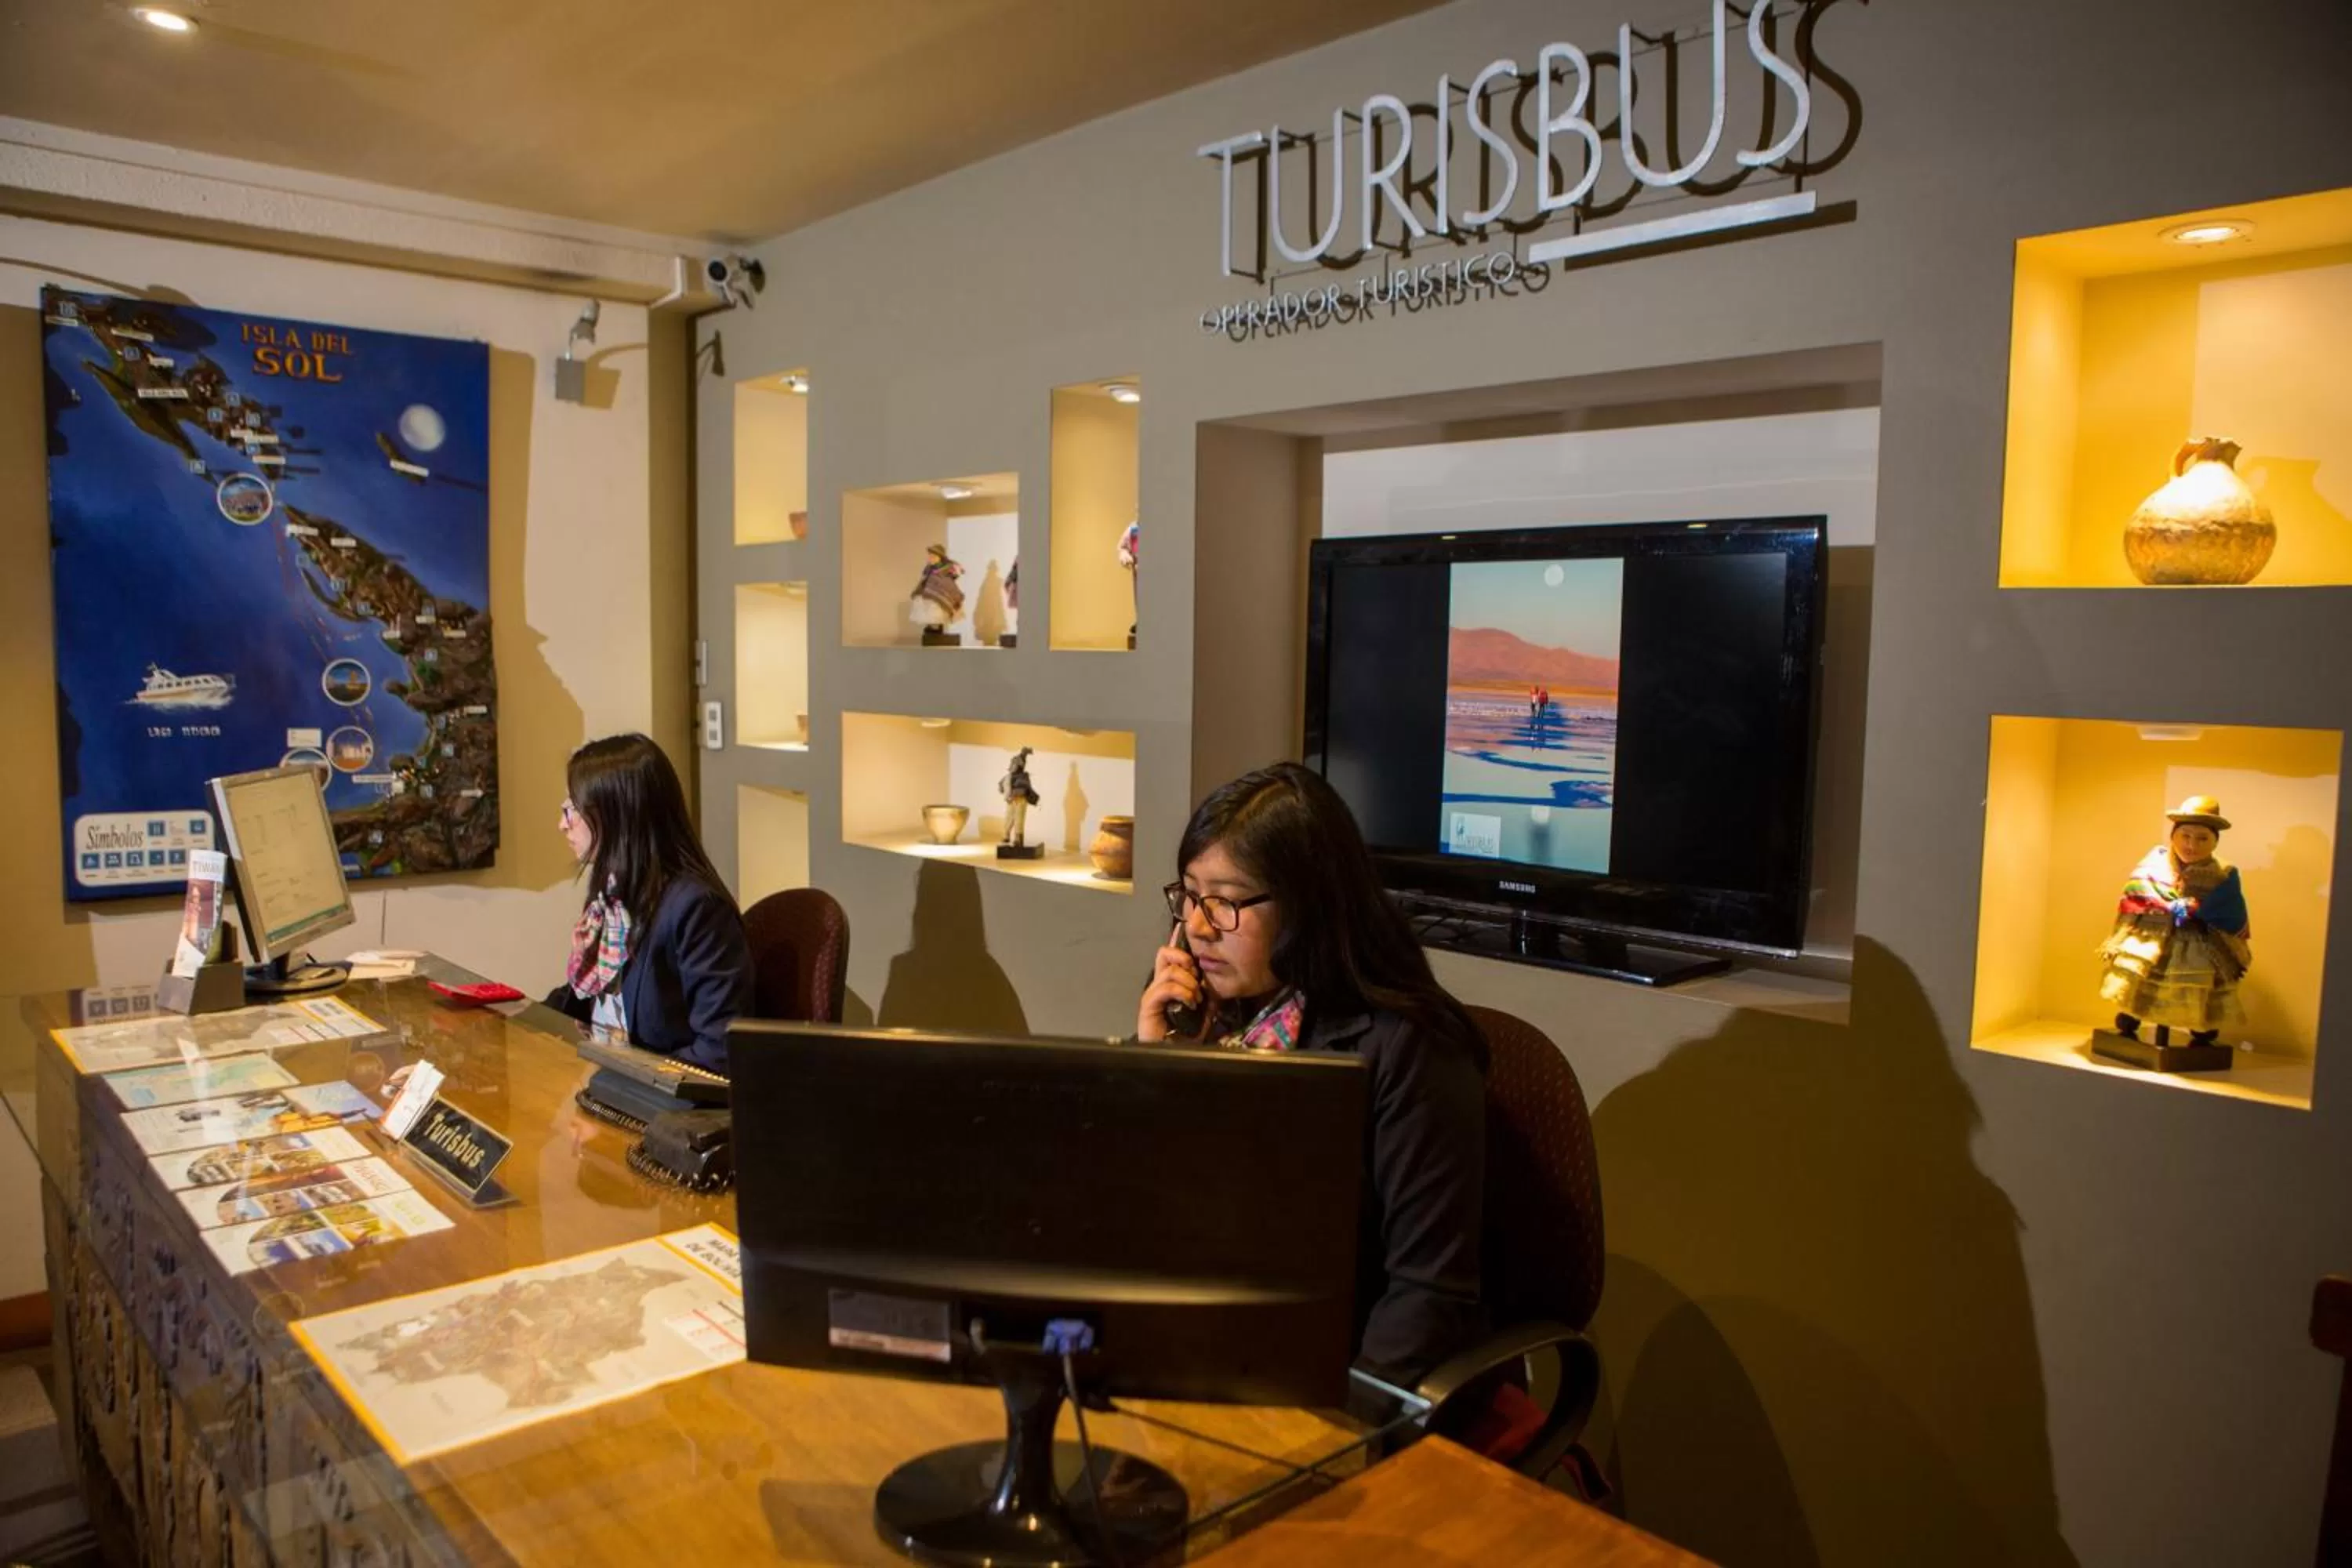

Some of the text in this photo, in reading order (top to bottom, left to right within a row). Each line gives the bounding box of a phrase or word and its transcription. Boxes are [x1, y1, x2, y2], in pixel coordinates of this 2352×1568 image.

[1197, 0, 1810, 276] TURISBUS
[1200, 251, 1516, 336] OPERADOR TURISTICO
[241, 324, 352, 355] ISLA DEL
[252, 347, 343, 383] SOL
[1499, 880, 1536, 893] SAMSUNG
[423, 1112, 485, 1167] Turisbus
